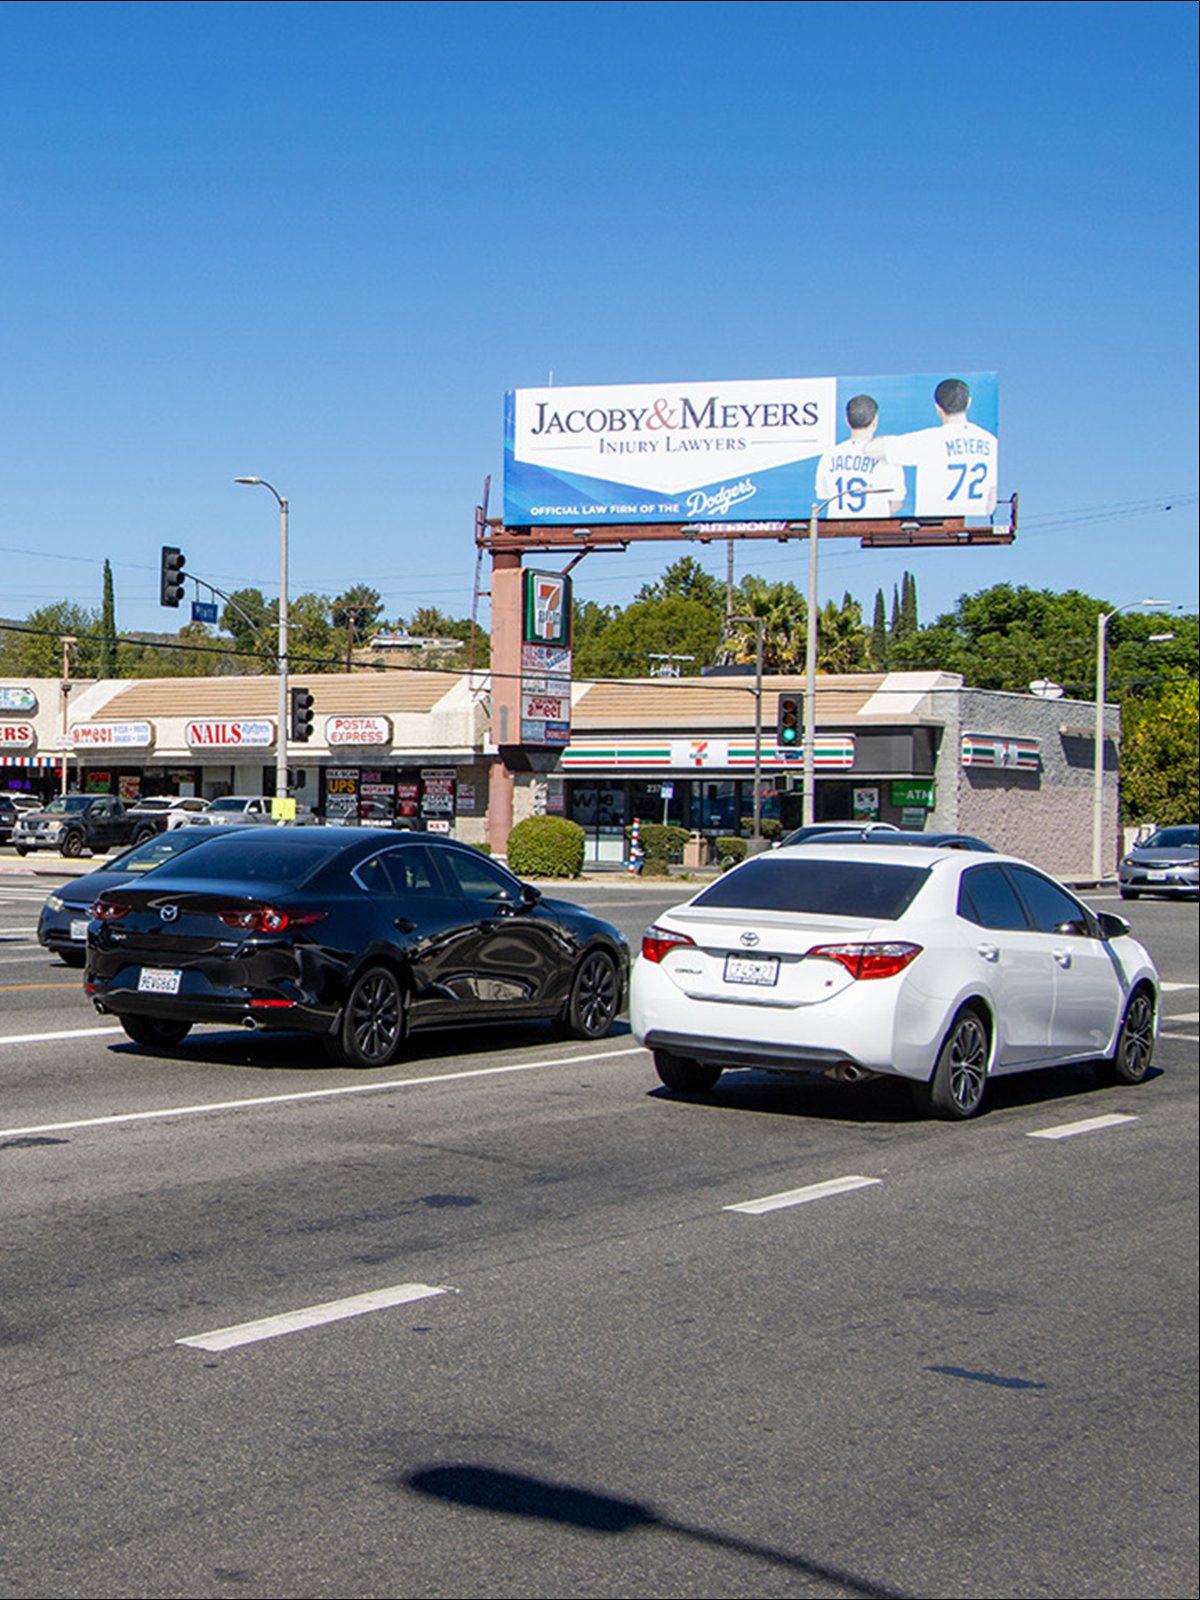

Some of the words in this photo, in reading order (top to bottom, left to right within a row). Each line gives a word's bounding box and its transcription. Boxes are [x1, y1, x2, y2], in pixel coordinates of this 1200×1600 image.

[599, 437, 660, 455] INJURY
[666, 436, 747, 452] LAWYERS
[945, 438, 991, 456] MEYERS
[829, 454, 879, 474] JACOBY
[946, 462, 988, 501] 72
[530, 506, 580, 516] OFFICIAL
[581, 505, 608, 514] LAW
[609, 505, 638, 514] FIRM
[640, 504, 656, 513] OF
[657, 503, 680, 513] THE
[686, 477, 758, 518] Dodgers
[835, 476, 869, 512] 19
[191, 723, 242, 745] NAILS
[335, 719, 379, 730] POSTAL
[330, 731, 383, 743] EXPRESS
[329, 779, 356, 793] UPS
